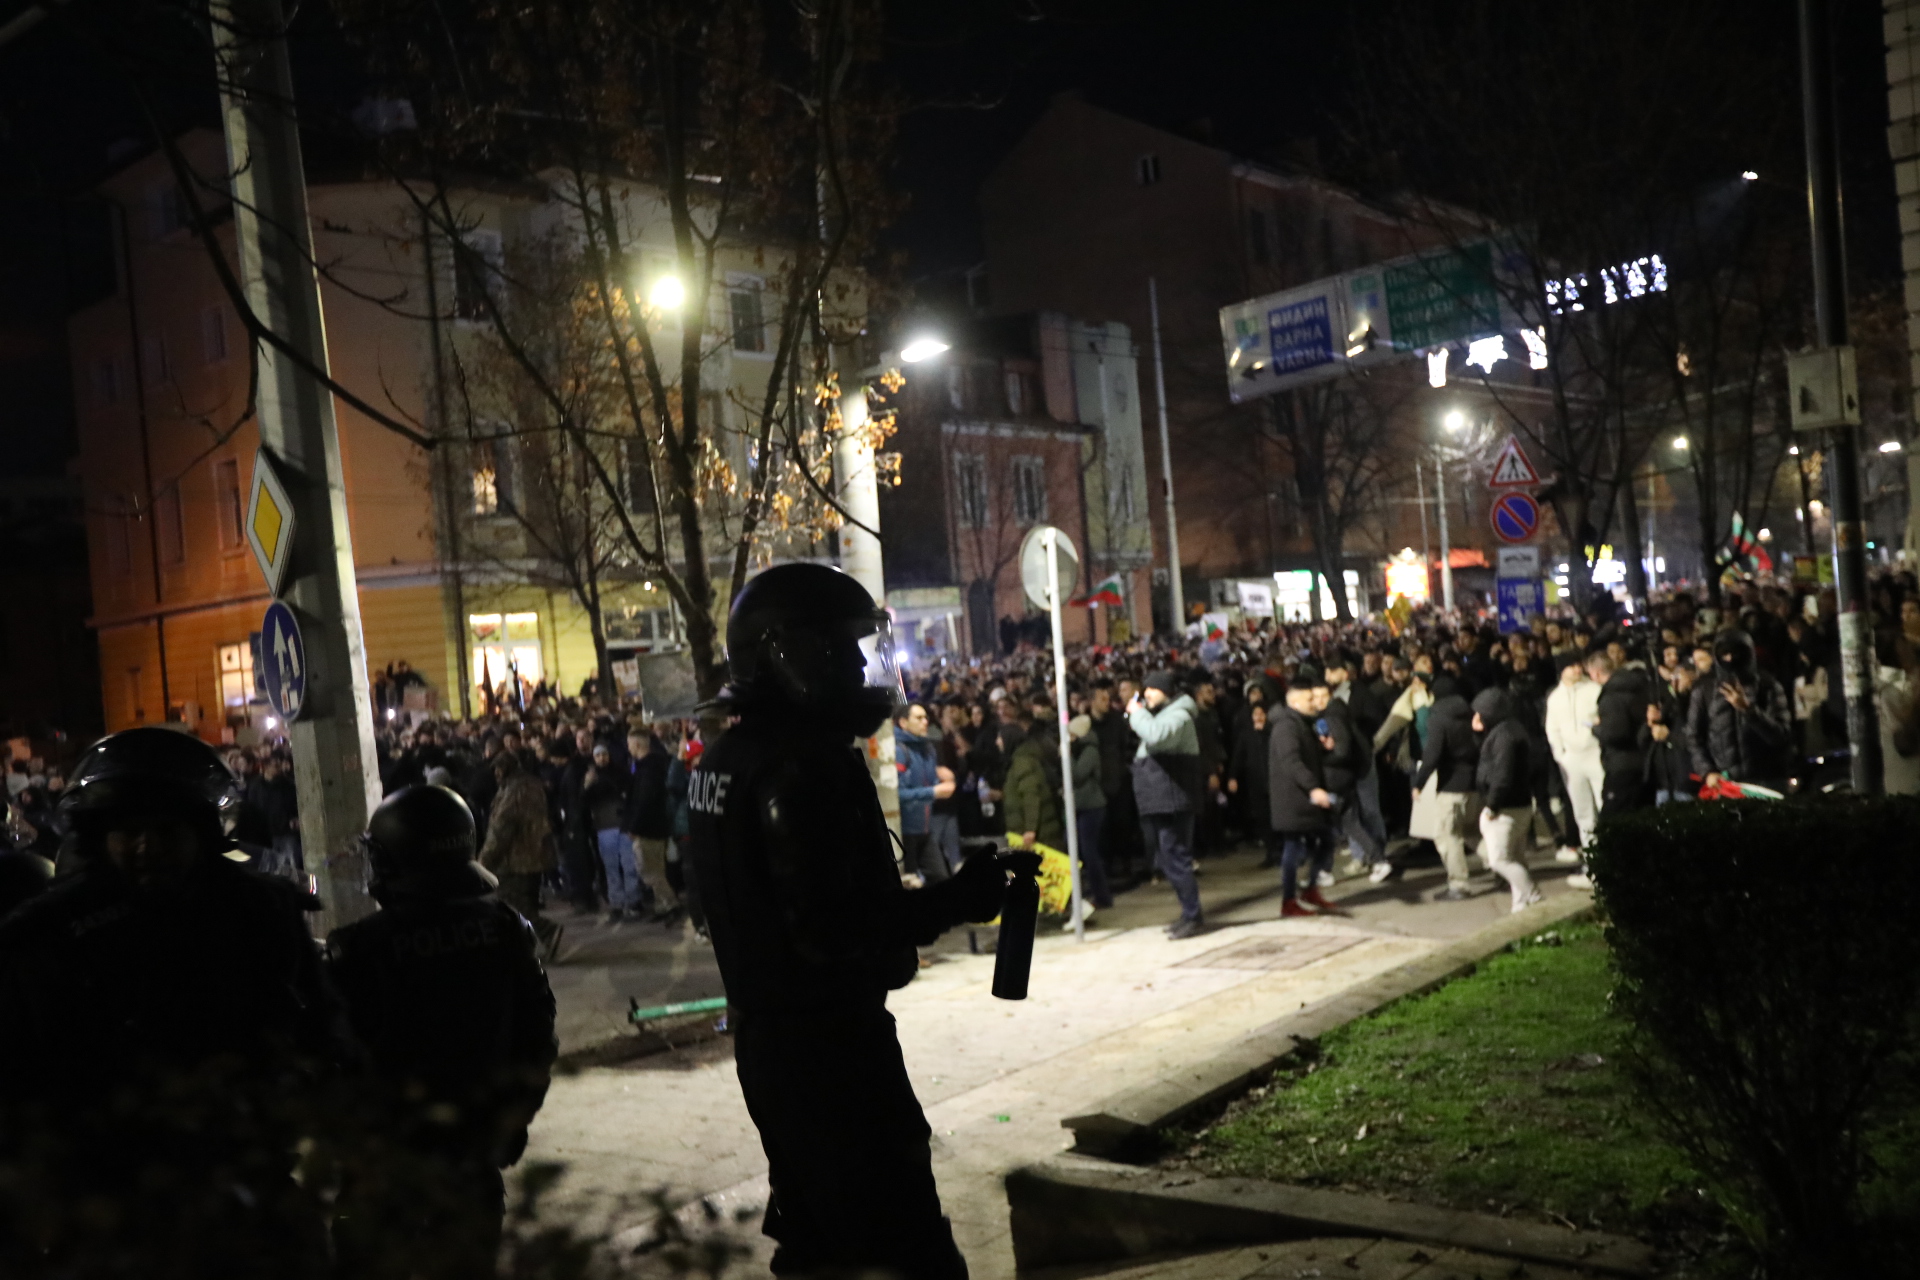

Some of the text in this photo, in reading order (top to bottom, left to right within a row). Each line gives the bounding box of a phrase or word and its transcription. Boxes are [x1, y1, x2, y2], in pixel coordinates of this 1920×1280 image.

[1274, 323, 1324, 350] ВАРНА
[1274, 345, 1327, 370] VARNA
[687, 769, 732, 815] OLICE
[391, 917, 499, 963] POLICE
